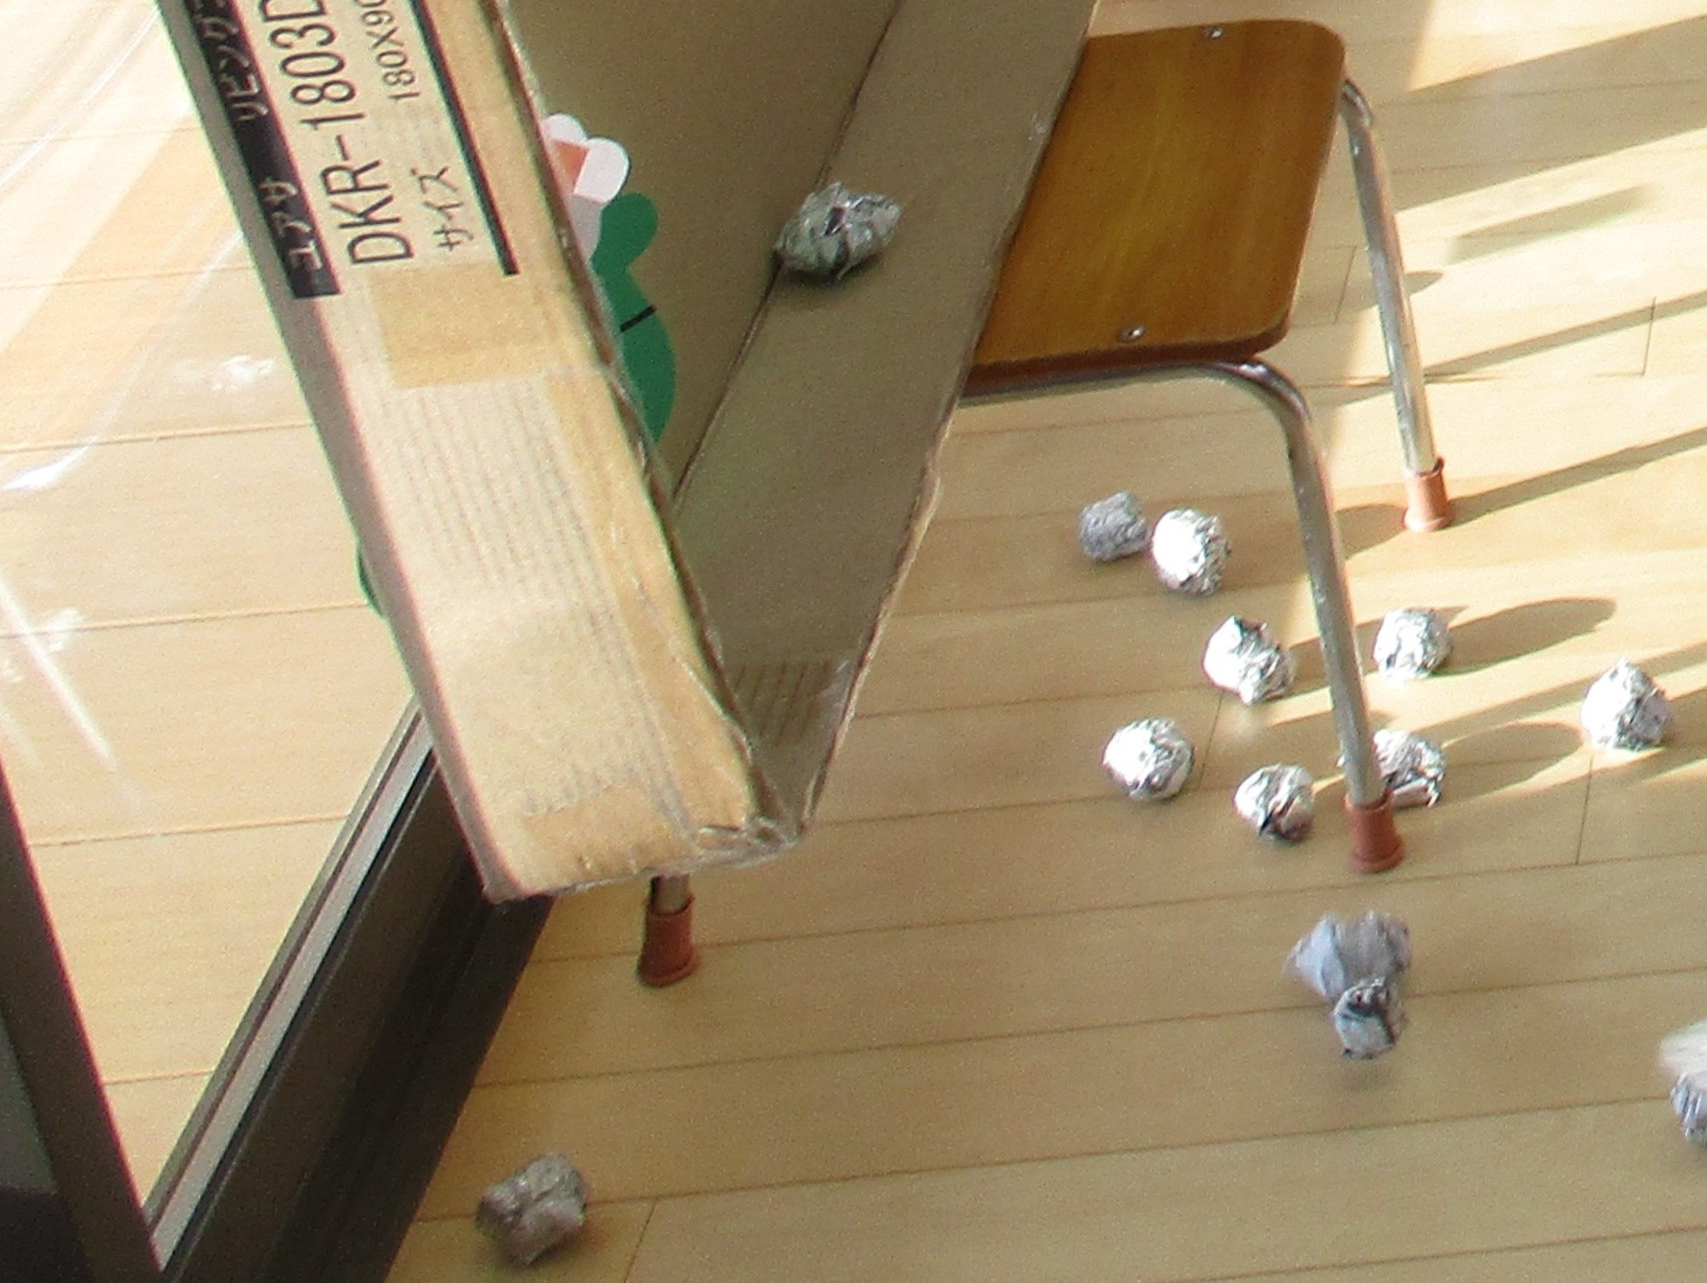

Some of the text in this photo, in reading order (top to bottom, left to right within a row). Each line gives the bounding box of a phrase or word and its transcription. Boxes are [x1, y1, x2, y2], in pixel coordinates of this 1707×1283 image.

[257, 176, 326, 272] ユアサ
[409, 166, 474, 253] サイズ
